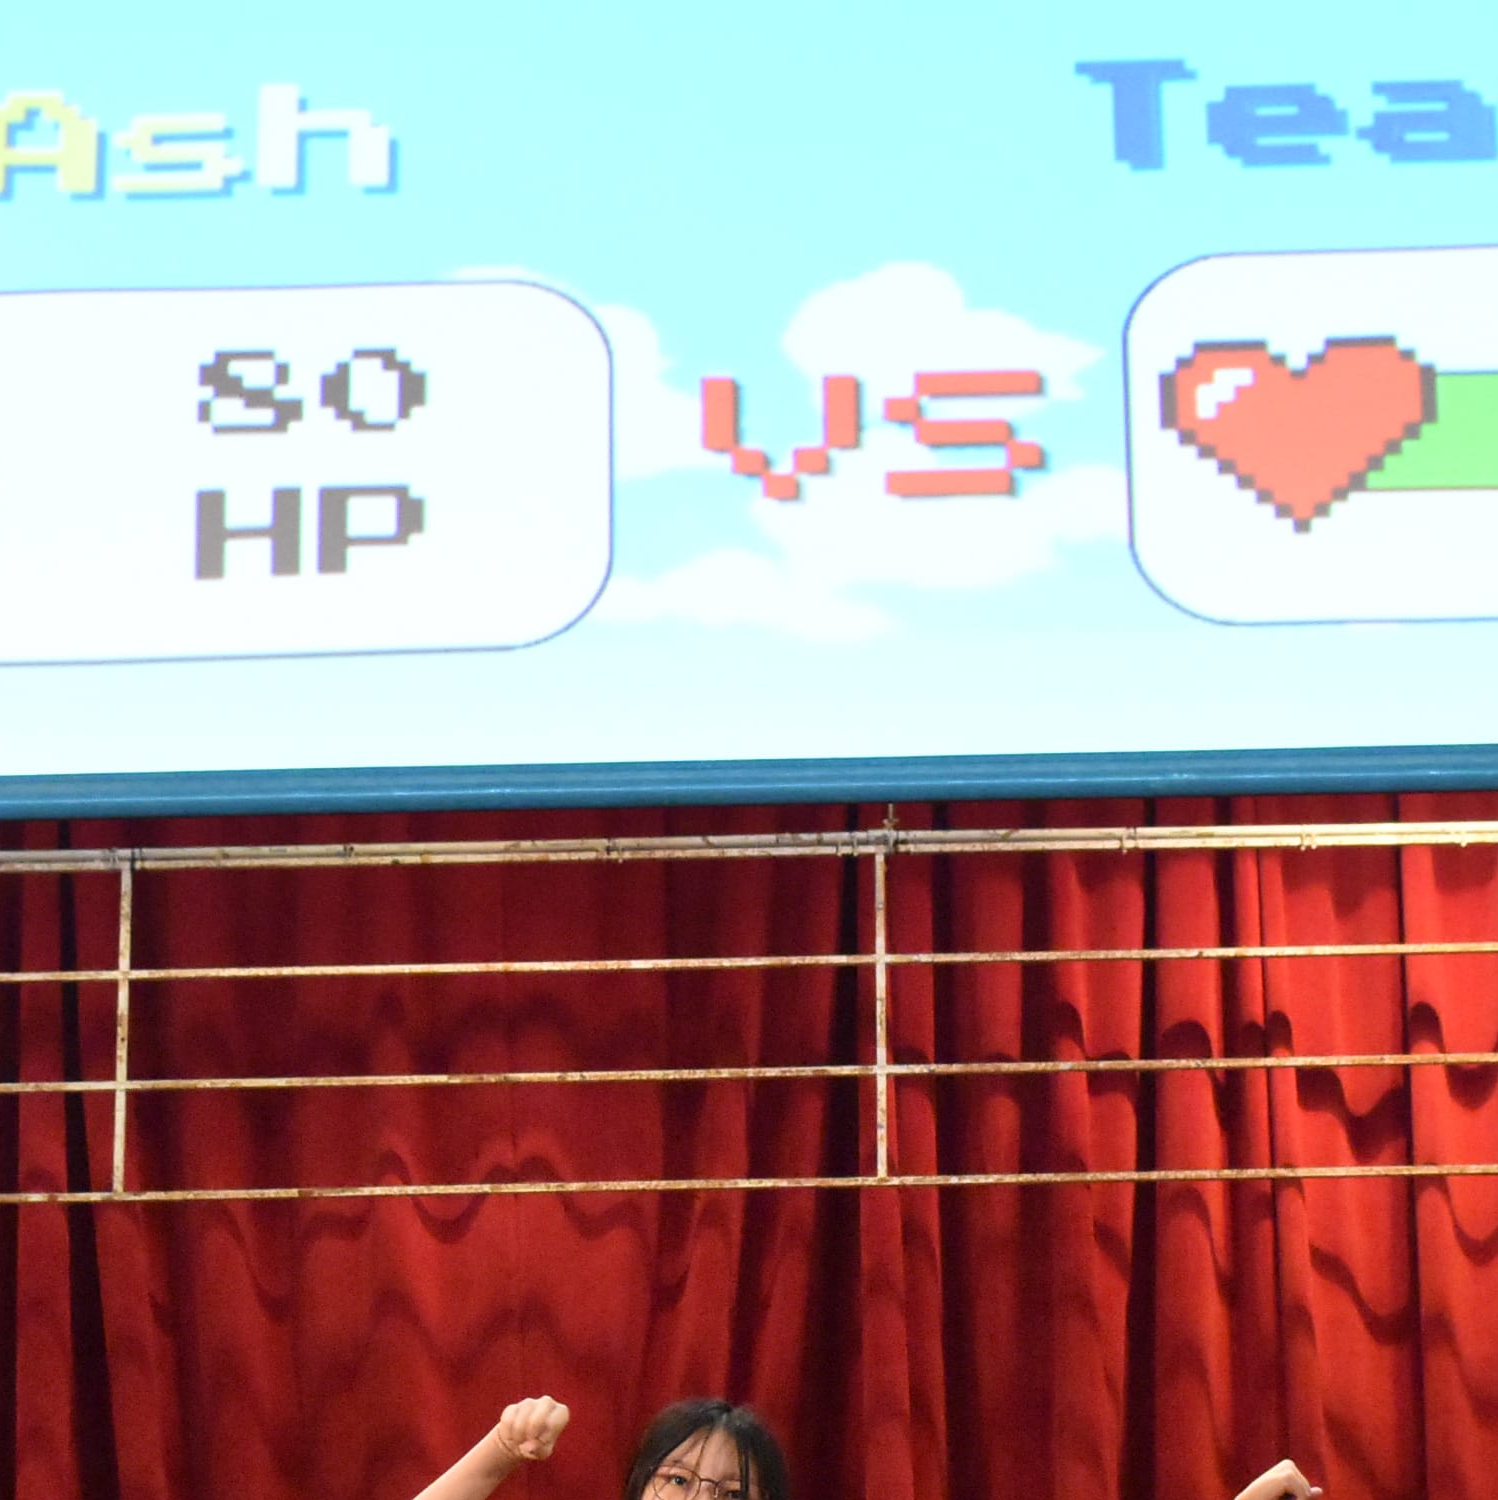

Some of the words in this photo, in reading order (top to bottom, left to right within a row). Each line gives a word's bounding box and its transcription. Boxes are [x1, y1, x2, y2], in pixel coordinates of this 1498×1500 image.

[198, 348, 427, 434] 80
[700, 370, 1046, 501] VS
[195, 484, 426, 580] HP
